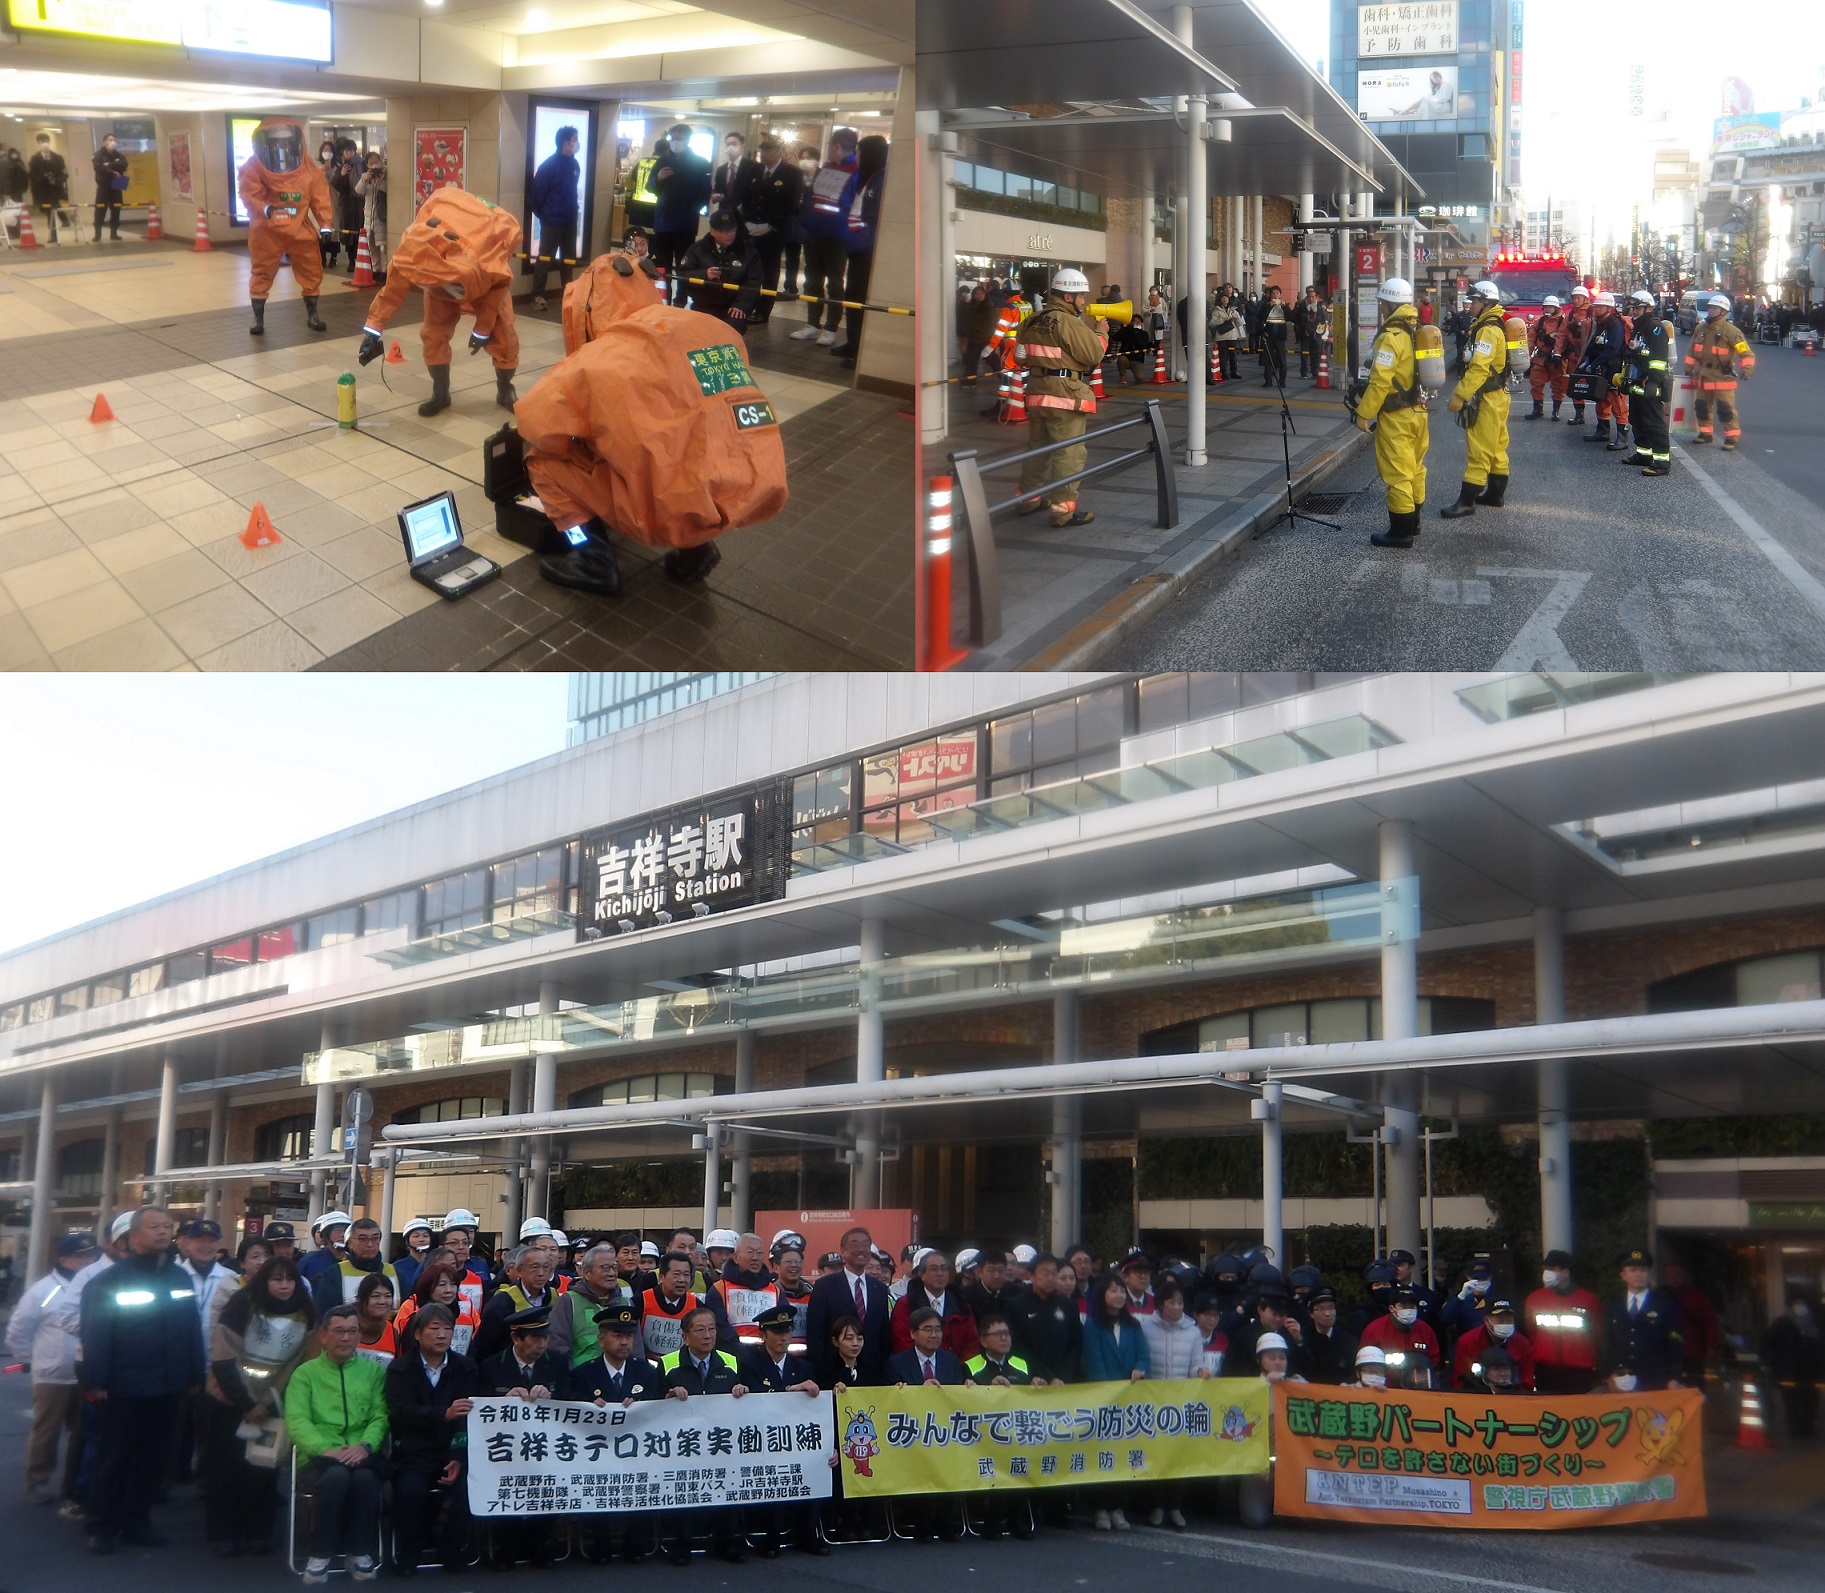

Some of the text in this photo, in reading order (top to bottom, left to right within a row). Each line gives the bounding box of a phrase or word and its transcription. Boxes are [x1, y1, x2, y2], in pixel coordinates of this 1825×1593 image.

[1363, 3, 1453, 23] 歯科・矯正歯科
[1362, 21, 1453, 36] 小児歯科・インプラント
[1717, 129, 1777, 143] 東京レジャーランド
[1439, 205, 1478, 217] 珈琲館
[1028, 232, 1053, 251] atré
[1363, 254, 1373, 270] 2
[393, 346, 402, 359] 2
[738, 404, 775, 425] CS-1
[256, 516, 265, 529] 6
[597, 812, 746, 899] 吉祥寺駅
[594, 871, 742, 921] Kichijōji Station
[250, 1222, 257, 1234] 3
[736, 1291, 769, 1307] 負傷者
[478, 1404, 627, 1426] 令和8年1月23日
[886, 1401, 1212, 1448] みんなで繋ごう防災の輪
[1286, 1396, 1634, 1449] 武蔵野パートナーシップ
[485, 1421, 824, 1464] 吉祥寺テロ対策実働訓練
[854, 1446, 868, 1457] 119
[978, 1449, 1146, 1478] 武蔵野消防署
[499, 1463, 803, 1488] 武蔵野市・武蔵野消防署・三鷹消防署・警備第二課
[1317, 1472, 1447, 1497] ANTEP Musashino
[497, 1474, 804, 1500] 第七機動隊・武蔵野警察署・関東バス・JR吉祥寺駅
[486, 1486, 813, 1513] アトレ吉祥寺店・吉祥寺活性化協議会・武蔵野防犯協会
